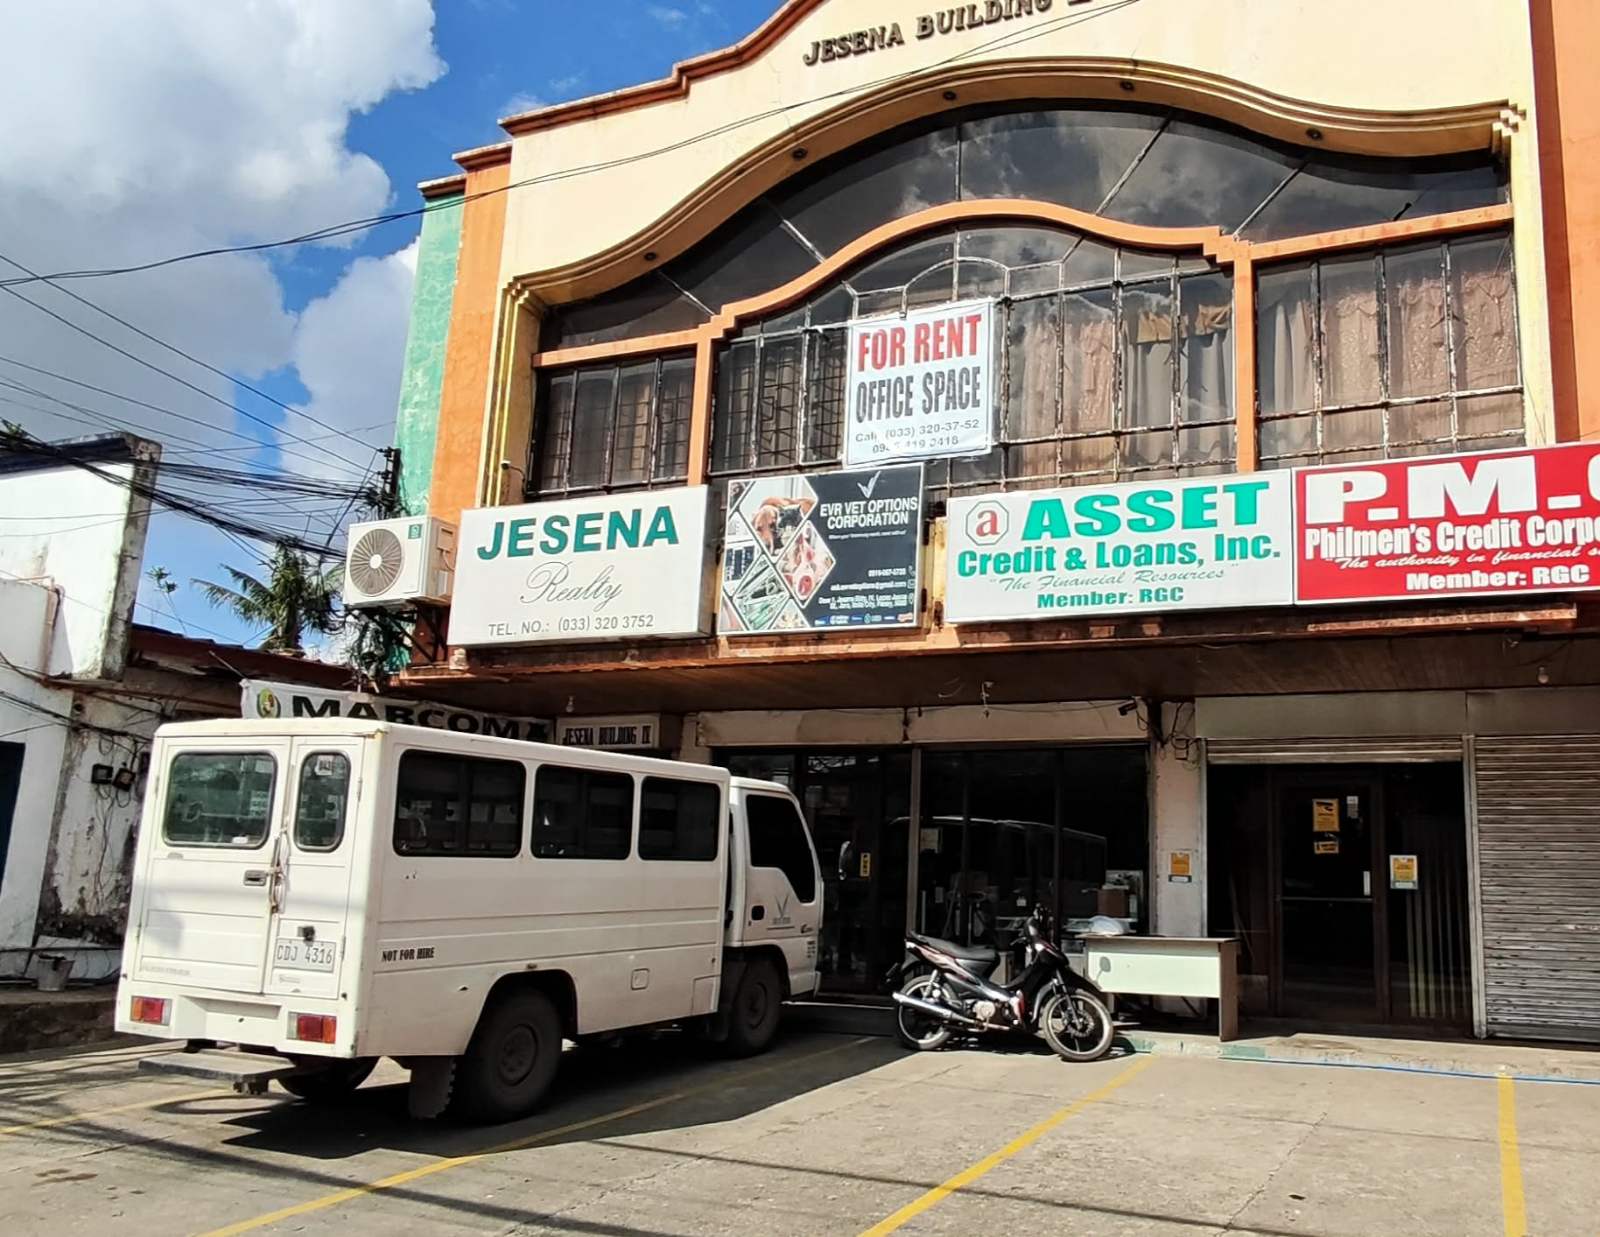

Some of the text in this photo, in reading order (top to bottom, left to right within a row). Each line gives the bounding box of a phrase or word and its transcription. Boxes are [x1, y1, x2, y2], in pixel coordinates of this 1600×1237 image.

[802, 22, 905, 66] JESENA
[858, 314, 982, 372] FOR RENT
[856, 366, 981, 423] OFFICE SPACE
[885, 426, 915, 440] (033)
[919, 419, 980, 435] 320-37-52
[820, 496, 918, 517] EVR VET OPTIONS
[1021, 481, 1270, 541] ASSET
[827, 511, 909, 530] CORPORATION
[477, 505, 679, 561] JESENA
[1305, 525, 1432, 560] Philmen's
[1437, 518, 1522, 554] Credit
[958, 533, 1281, 578] Credit & Loans, Inc.
[1375, 553, 1460, 568] authority
[1467, 553, 1486, 563] in
[1492, 546, 1581, 566] financial
[520, 561, 623, 613] Realty
[1037, 571, 1126, 591] Financial
[1406, 564, 1590, 591] Member: RGC
[1036, 587, 1185, 609] Member: RGC
[488, 615, 654, 637] TEL. NO.: (033) 320 3752
[562, 727, 594, 746] JESENA
[598, 725, 638, 745] BUILDING
[304, 946, 333, 965] 4316
[381, 946, 435, 962] NOT FOR HIRE
